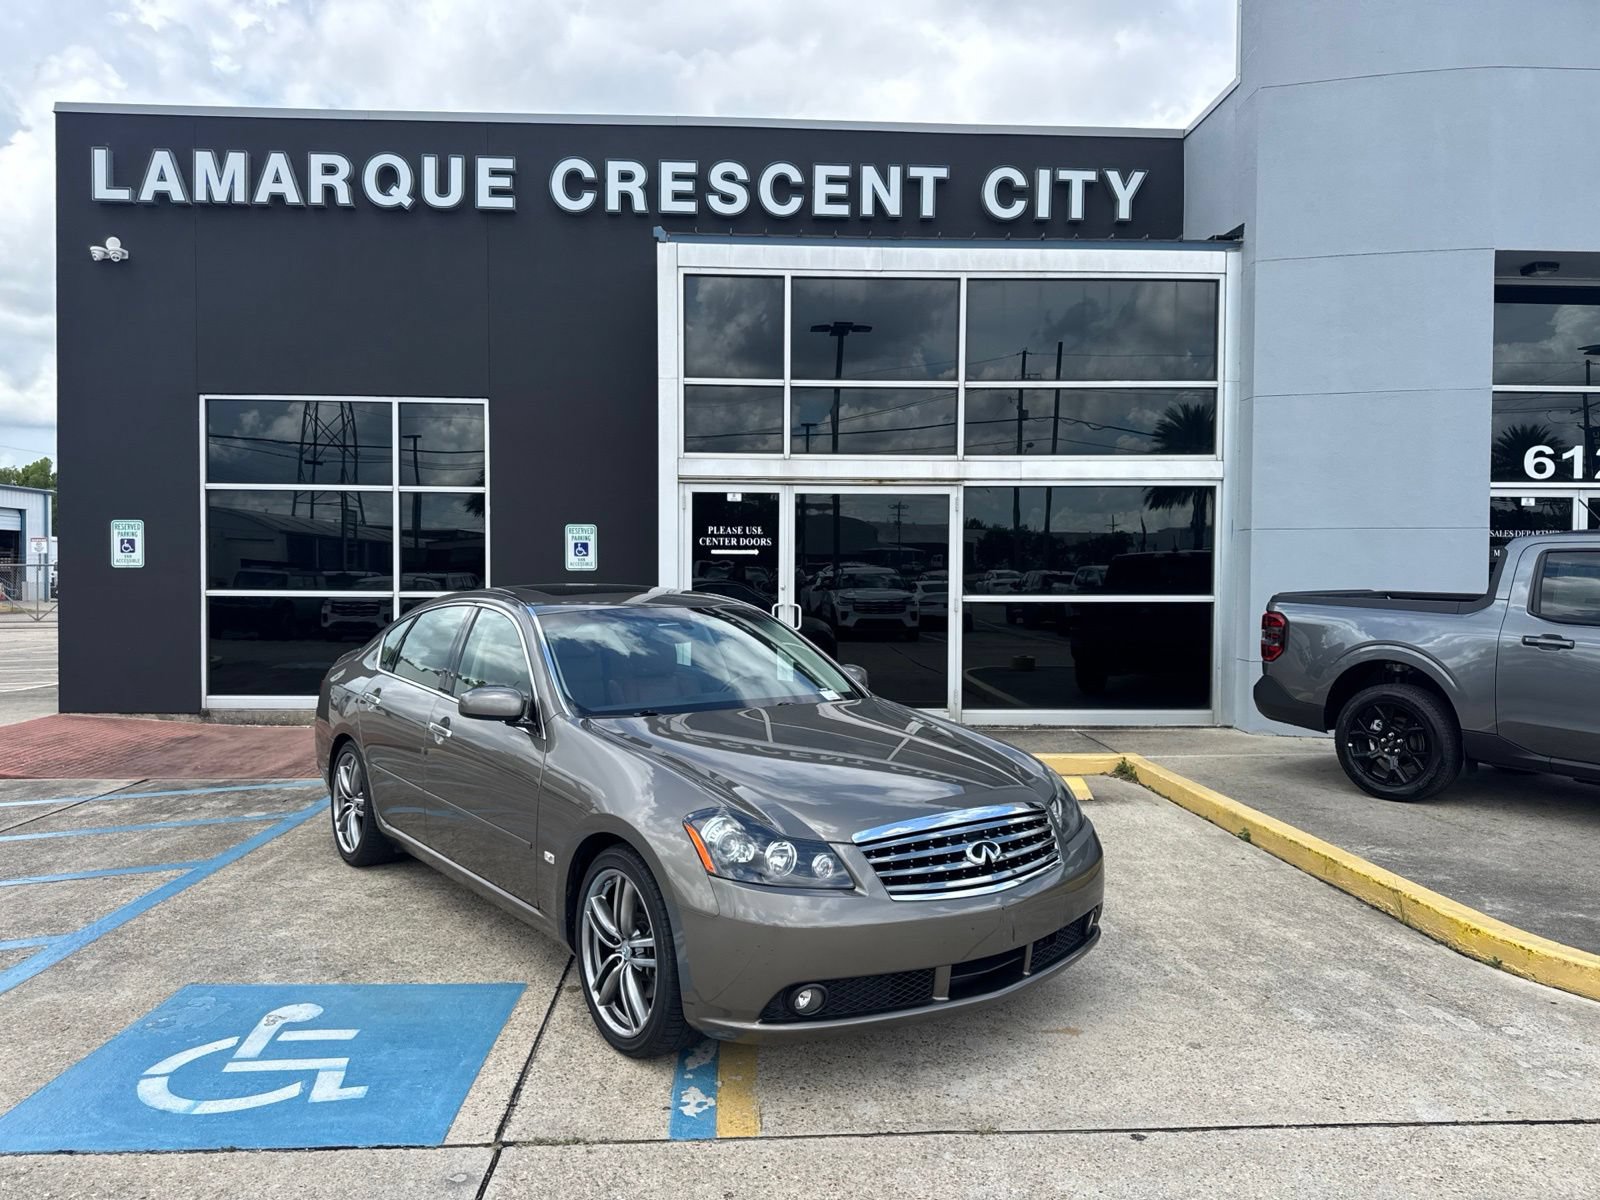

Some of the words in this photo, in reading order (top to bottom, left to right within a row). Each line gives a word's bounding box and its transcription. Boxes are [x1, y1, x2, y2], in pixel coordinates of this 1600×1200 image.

[91, 147, 516, 210] LAMARQUE
[549, 156, 950, 218] CRESCENT
[981, 165, 1148, 222] CITY
[1524, 445, 1600, 480] 61
[708, 526, 744, 535] PLEASE
[745, 526, 764, 535] USE
[1490, 529, 1514, 538] SALES
[699, 537, 738, 546] CENTER
[739, 537, 772, 546] DOORS
